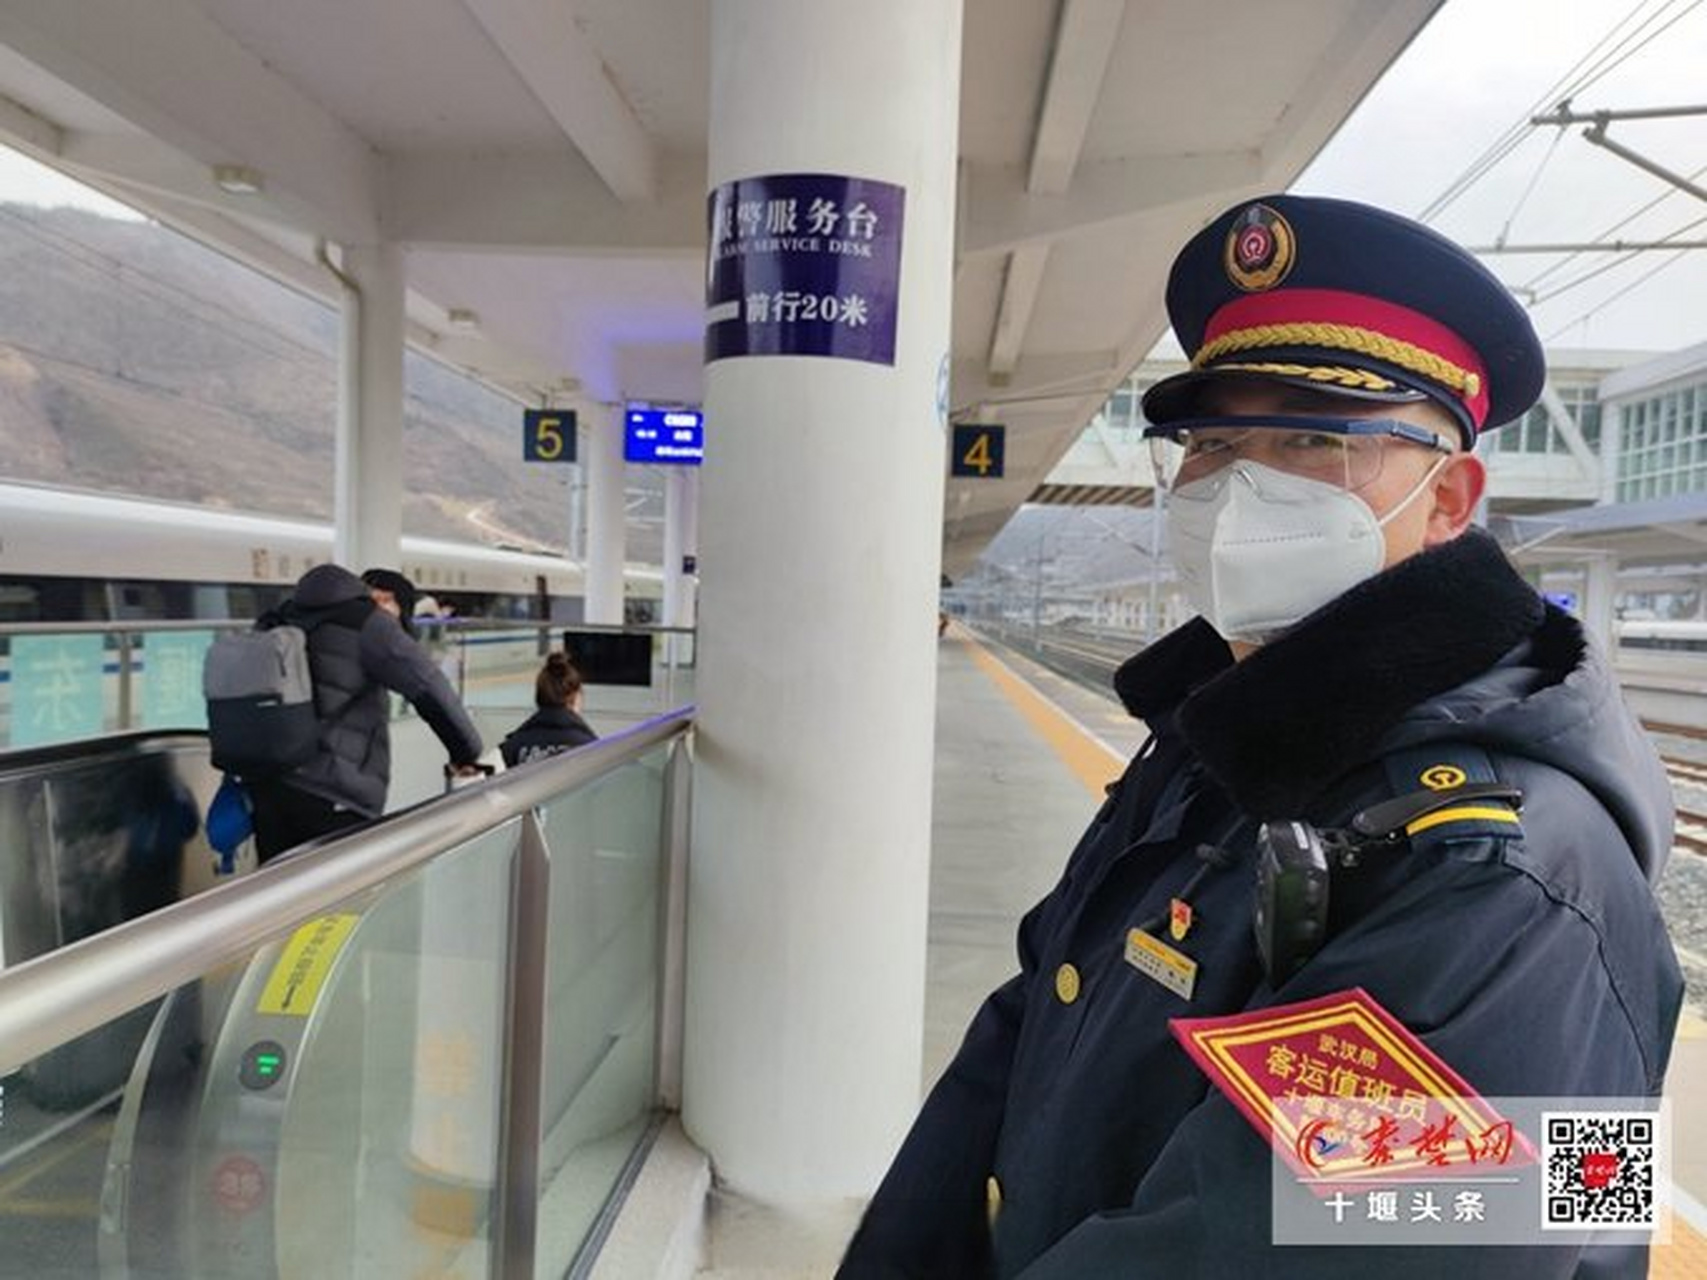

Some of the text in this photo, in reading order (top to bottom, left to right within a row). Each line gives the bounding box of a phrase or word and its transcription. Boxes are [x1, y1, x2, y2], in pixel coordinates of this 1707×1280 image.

[755, 237, 820, 251] SERVICE
[829, 239, 871, 257] DESK
[746, 291, 867, 326] 前行20米
[536, 418, 562, 458] 5
[963, 433, 992, 474] 4
[1319, 1033, 1379, 1070] 武汉局
[1266, 1044, 1427, 1125] 客运值班员
